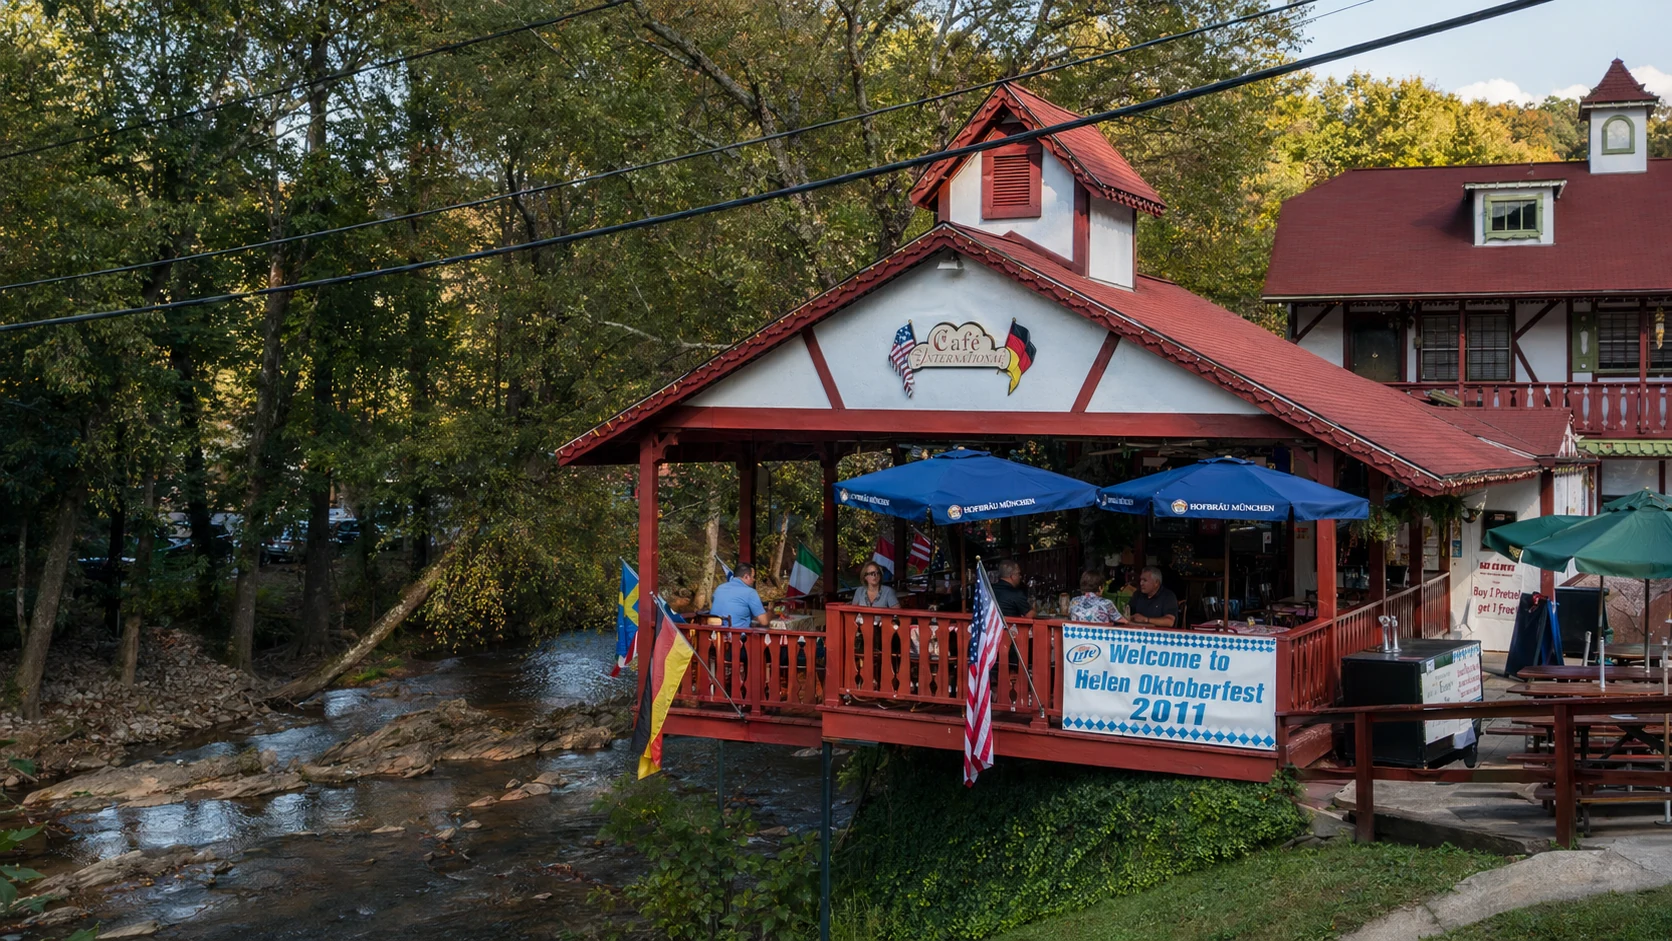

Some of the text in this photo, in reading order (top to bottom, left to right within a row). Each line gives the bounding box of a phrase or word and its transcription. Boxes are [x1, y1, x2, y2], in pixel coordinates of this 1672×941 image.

[933, 329, 980, 352] Café
[963, 498, 1036, 514] HOFBRÄU MÜNCHEN
[1190, 503, 1275, 512] HOFBRÄU MÜNCHEN
[1473, 586, 1488, 599] Buy
[1495, 588, 1521, 600] Pretzel
[1477, 603, 1490, 615] get
[1073, 649, 1096, 663] Lite
[1109, 644, 1230, 672] Welcome to
[1075, 669, 1265, 704] Helen Oktoberfest
[1129, 697, 1207, 726] 2011
